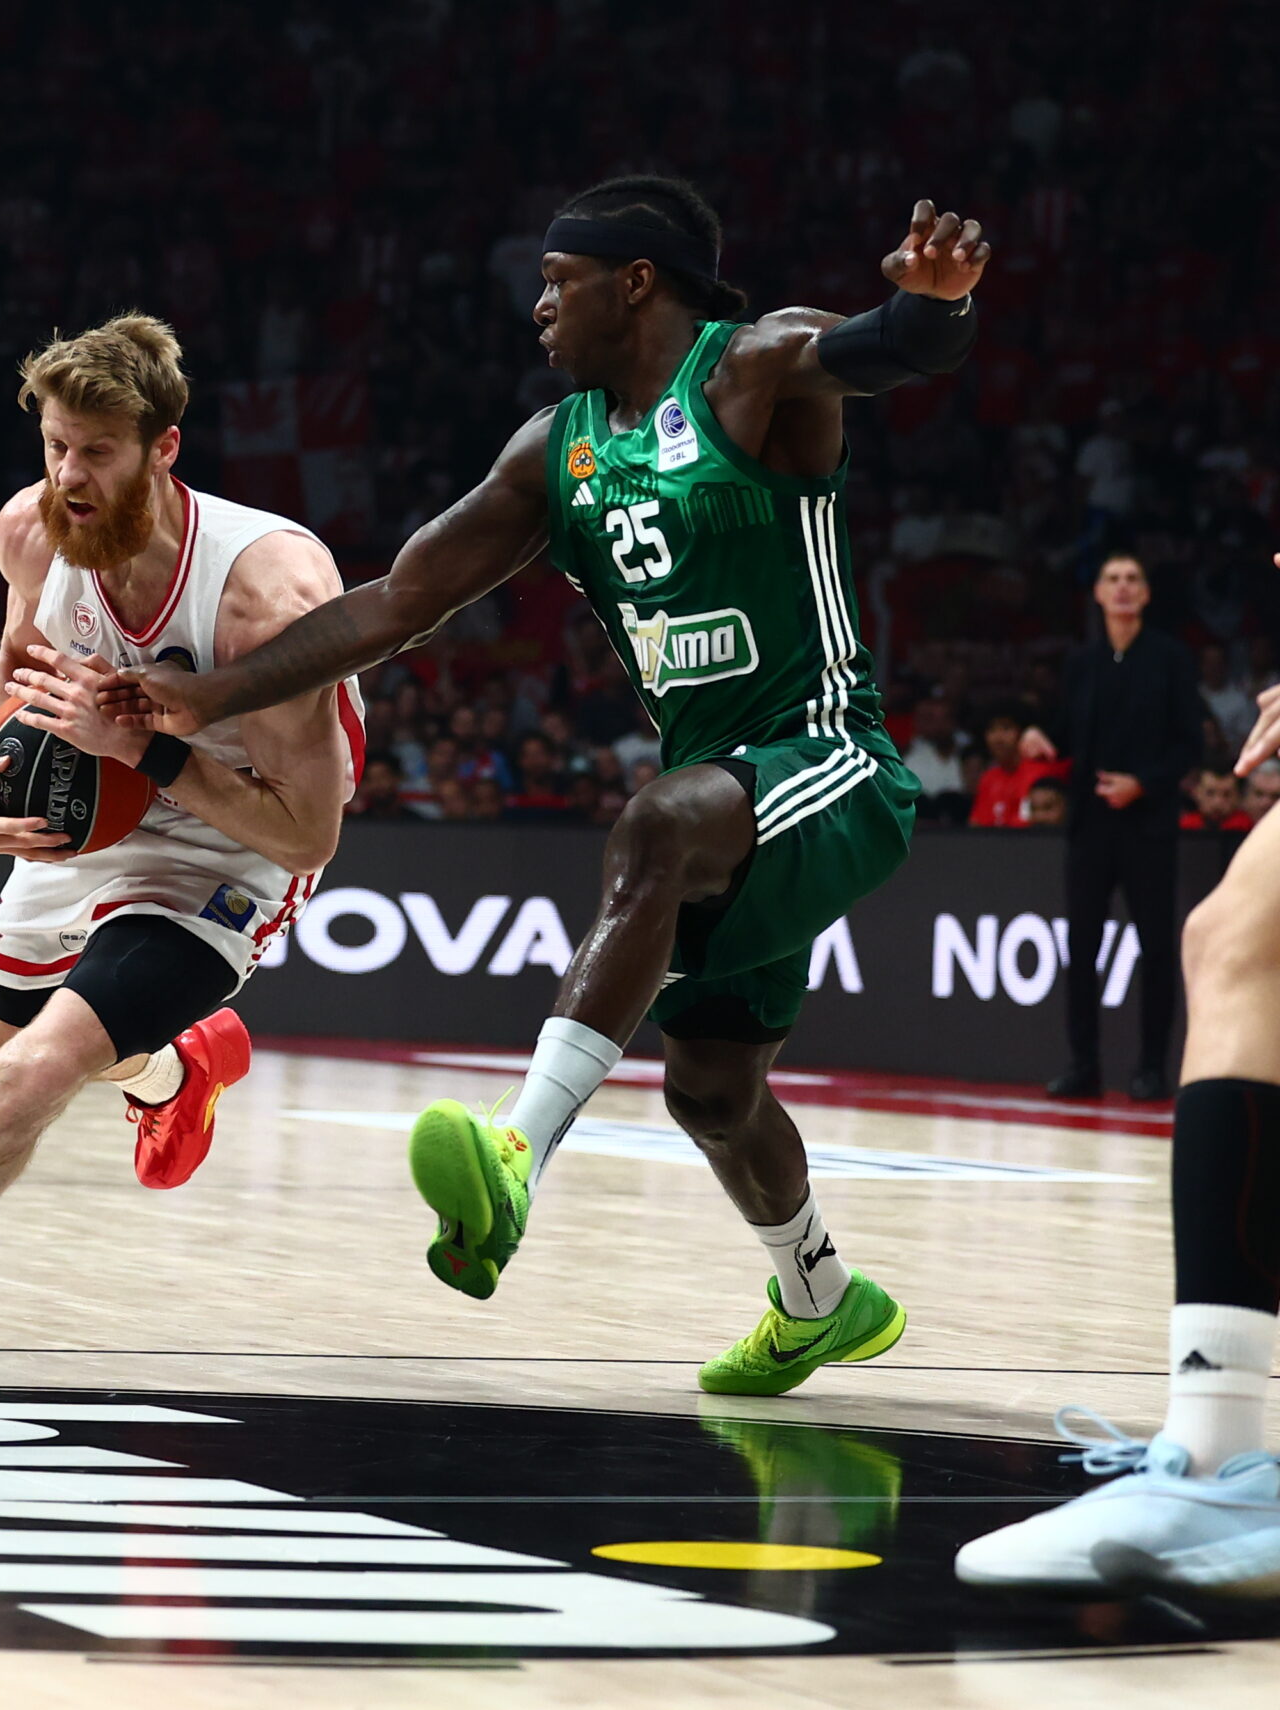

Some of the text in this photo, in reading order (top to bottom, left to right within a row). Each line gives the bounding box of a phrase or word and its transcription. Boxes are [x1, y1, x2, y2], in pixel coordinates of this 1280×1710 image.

[670, 451, 686, 462] GBL
[606, 500, 672, 583] 25
[256, 886, 577, 977] OVA
